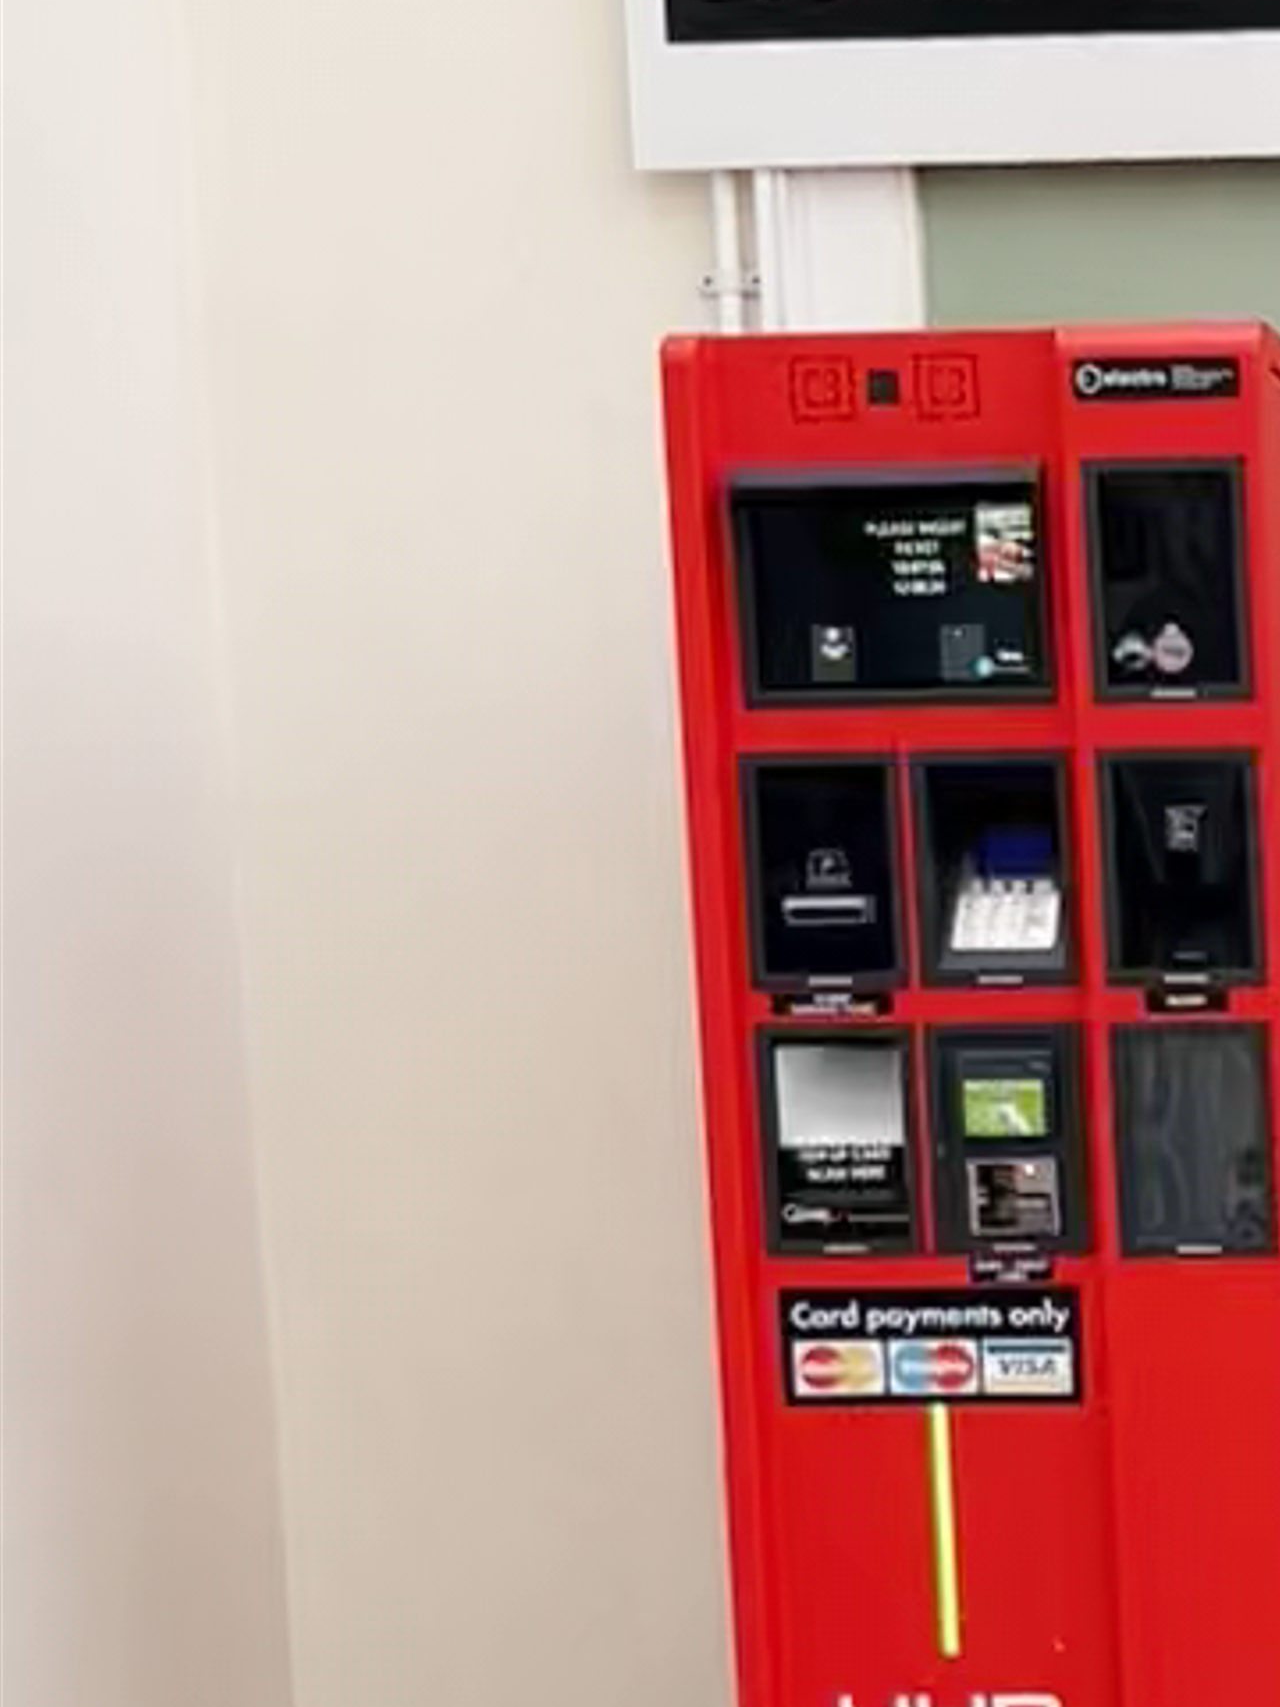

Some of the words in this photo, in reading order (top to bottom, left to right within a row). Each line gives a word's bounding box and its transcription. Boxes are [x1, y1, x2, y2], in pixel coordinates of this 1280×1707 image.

[790, 1301, 860, 1330] Card
[866, 1304, 1003, 1334] payments
[1008, 1298, 1070, 1333] only
[1000, 1359, 1057, 1376] VISA
